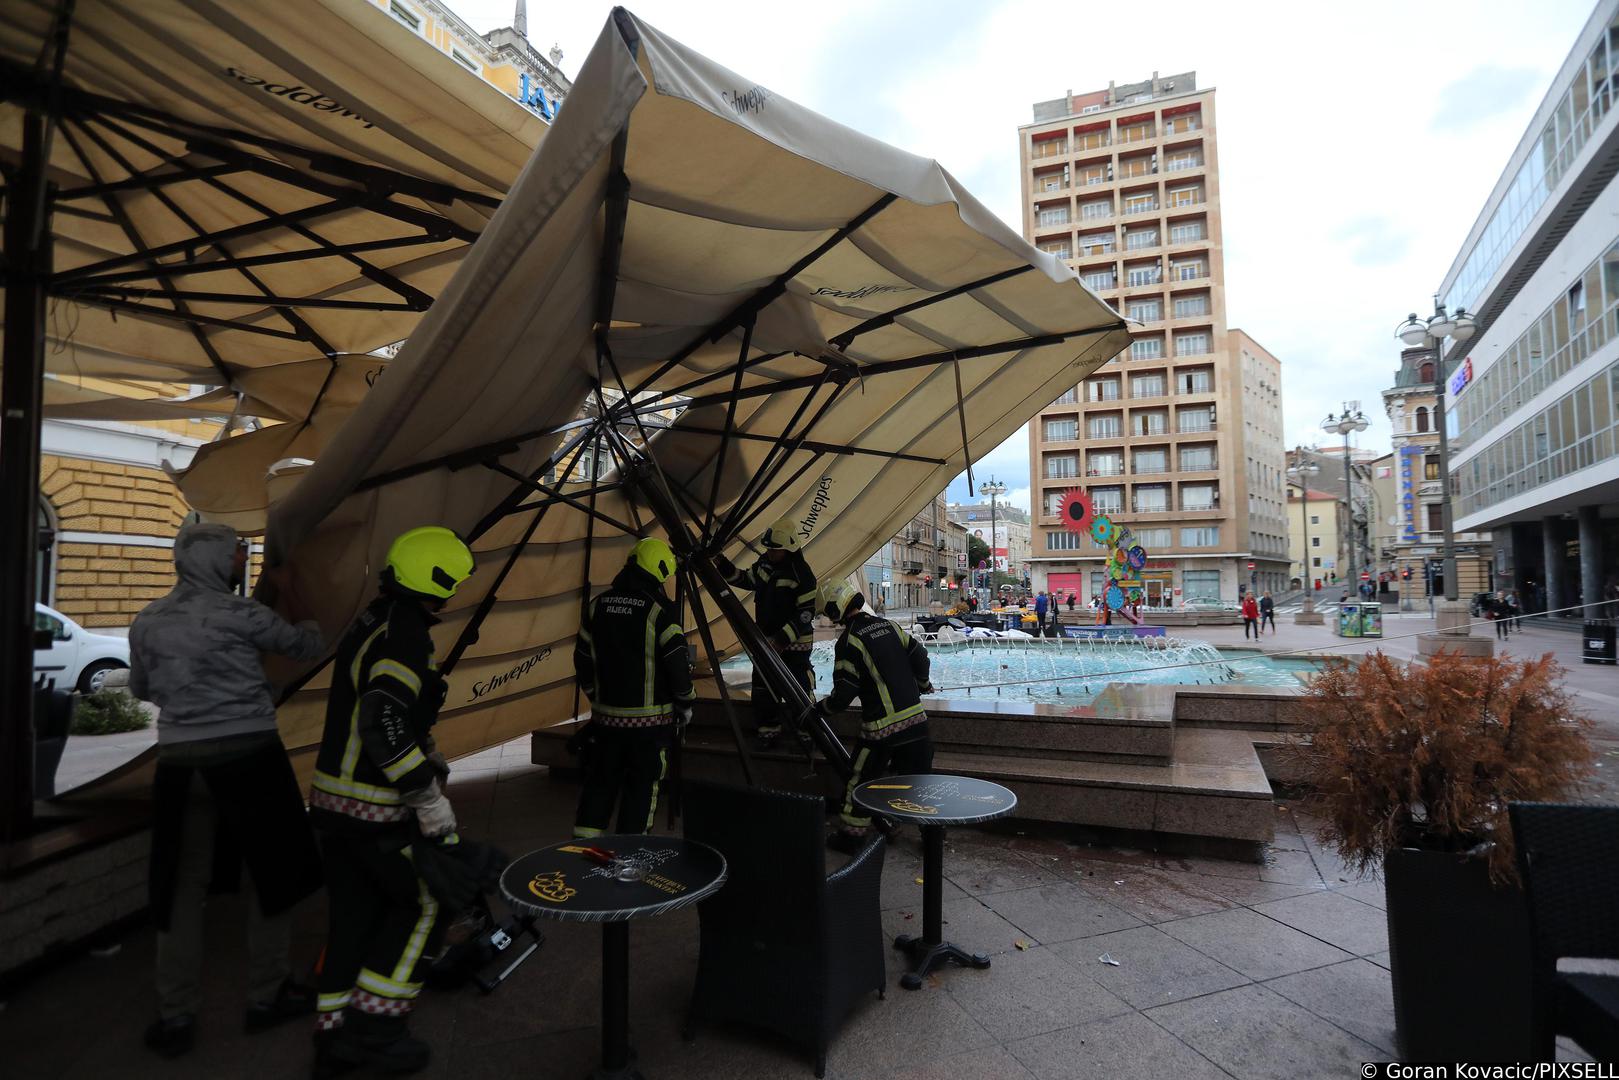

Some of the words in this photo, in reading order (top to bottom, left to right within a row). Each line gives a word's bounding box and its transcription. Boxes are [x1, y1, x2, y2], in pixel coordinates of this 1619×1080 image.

[798, 475, 832, 539] Schweppes
[606, 605, 633, 615] RIJEKA
[467, 646, 552, 702] Schweppes
